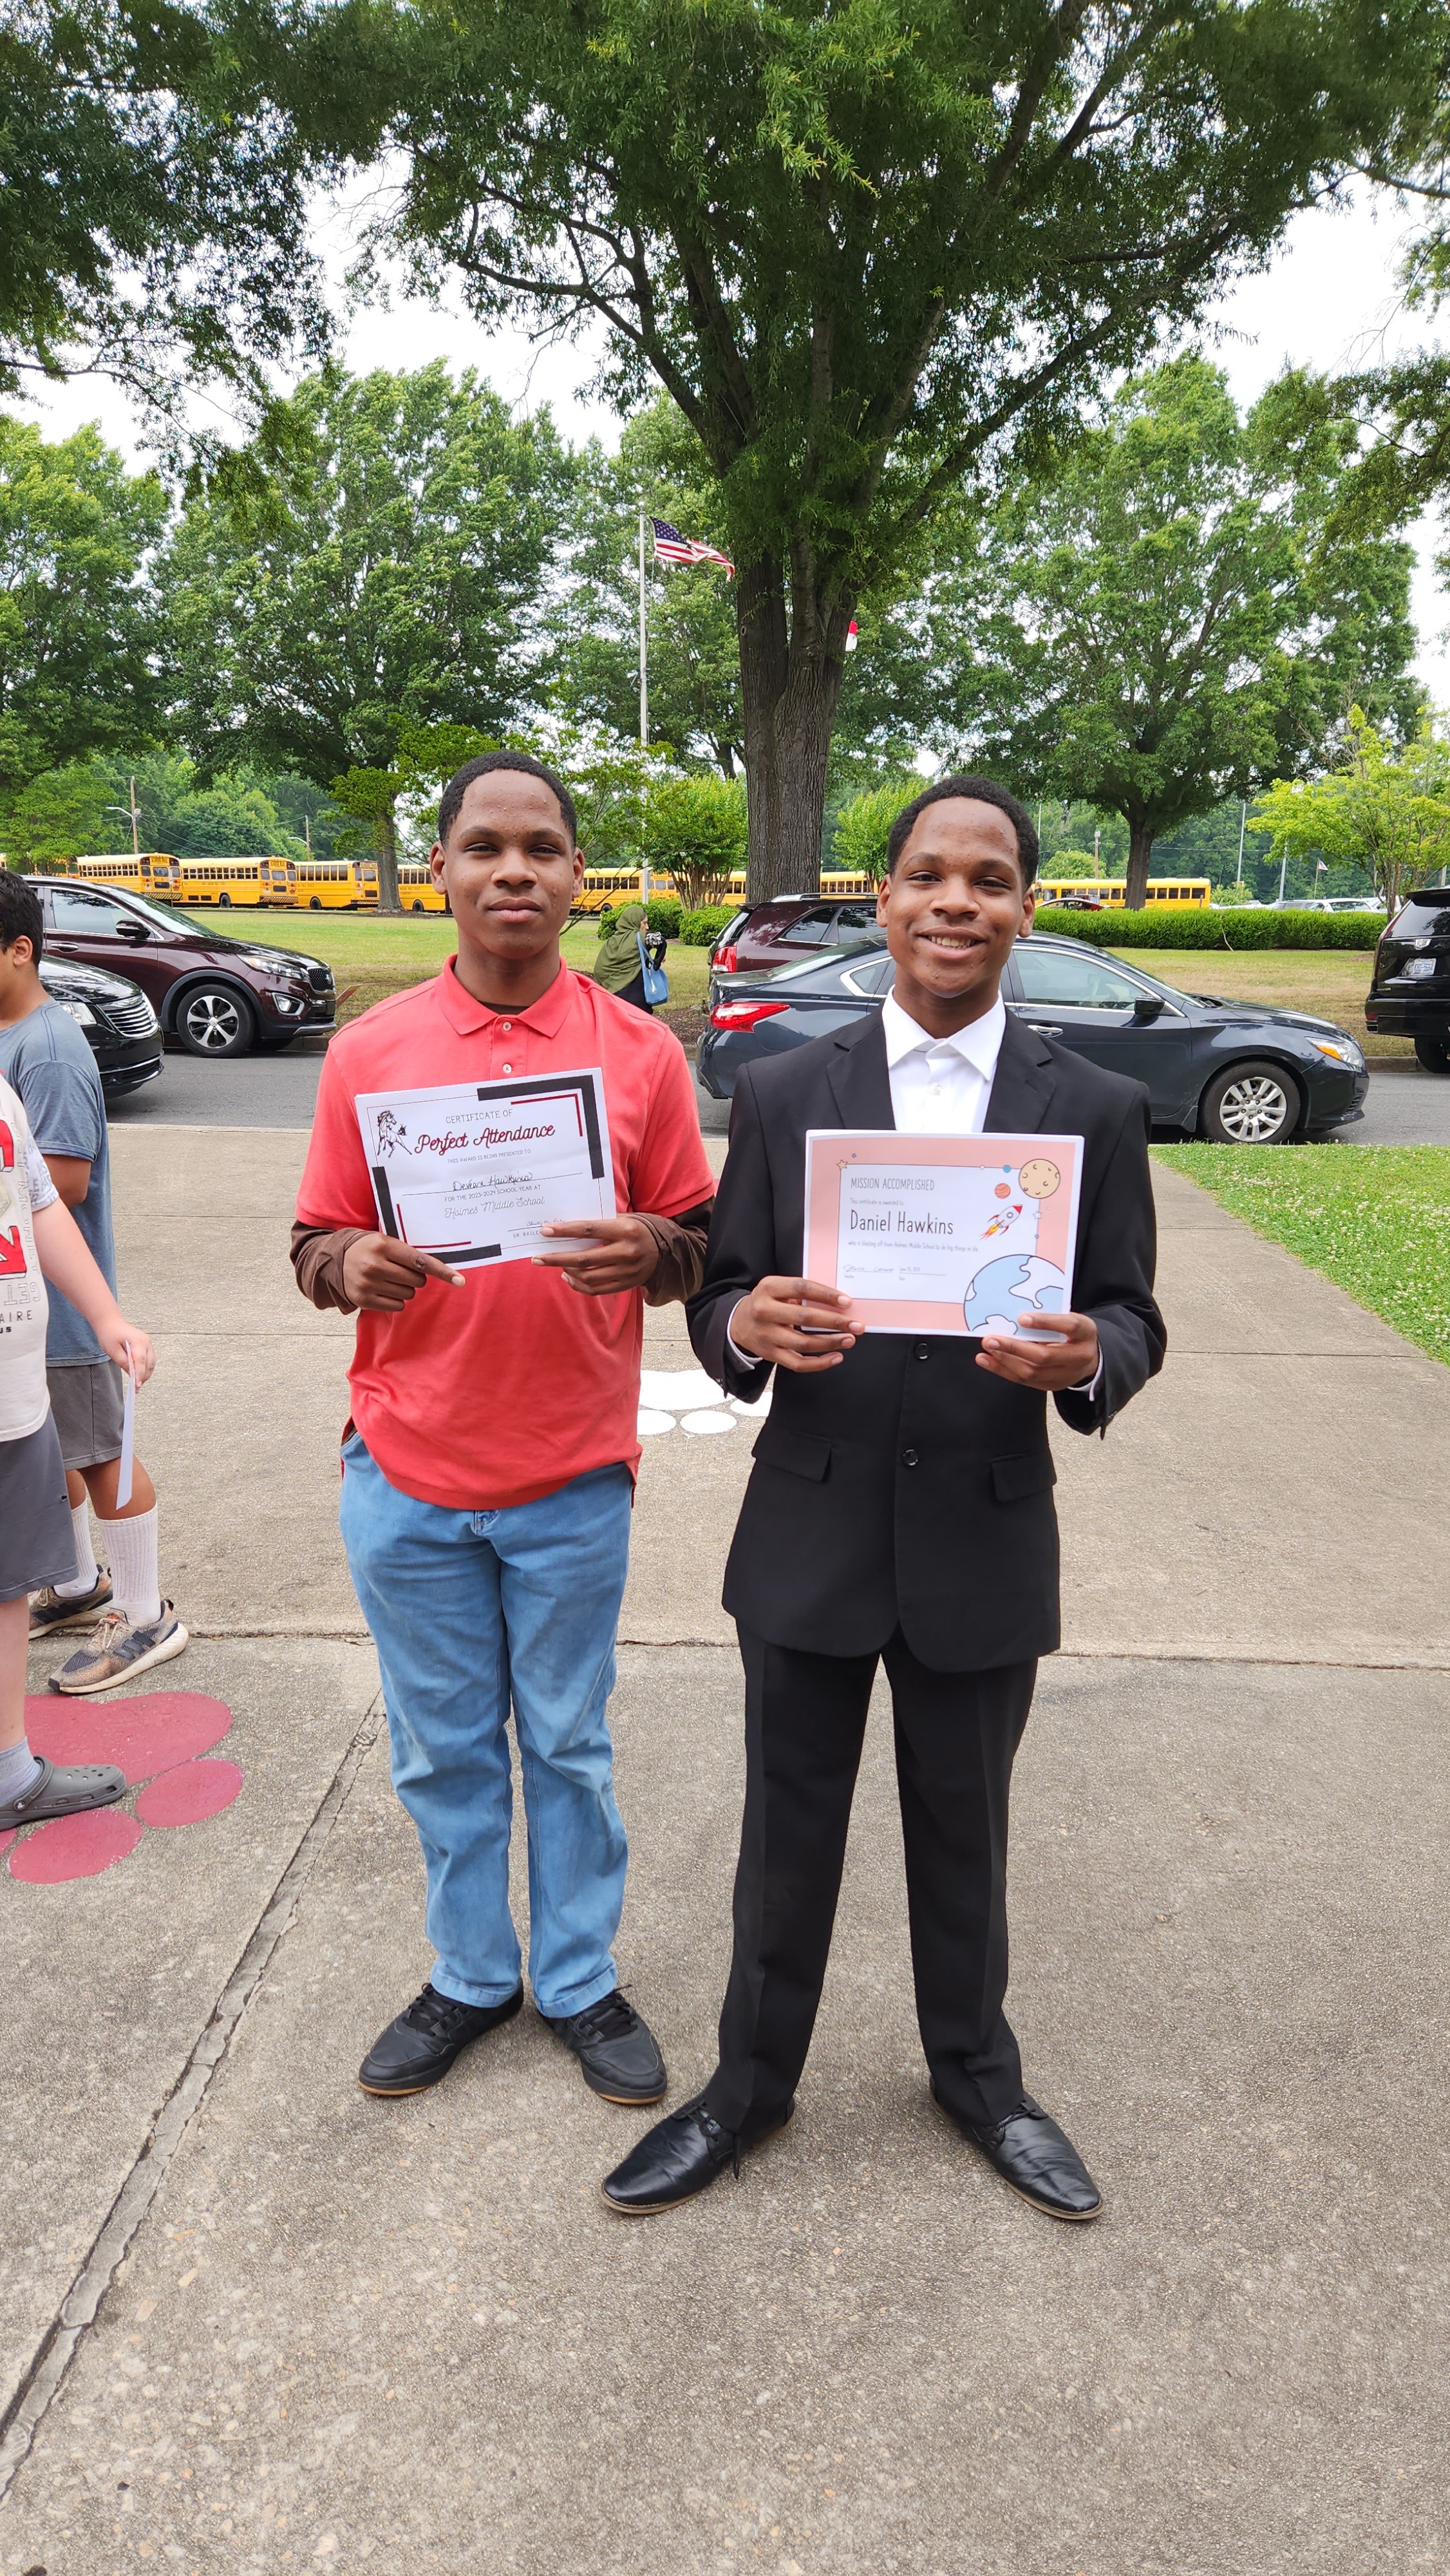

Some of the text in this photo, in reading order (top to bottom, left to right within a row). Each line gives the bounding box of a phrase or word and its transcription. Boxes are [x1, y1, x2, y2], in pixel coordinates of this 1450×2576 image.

[446, 1109, 513, 1124] CERTIFICATE OF
[414, 1125, 556, 1155] Perfect Attendance
[851, 1178, 935, 1191] MISSION ACCOMPLISHED
[469, 1190, 496, 1199] 2023-2024
[445, 1197, 545, 1219] Holmes Middle School
[851, 1209, 954, 1235] Daniel Hawkins
